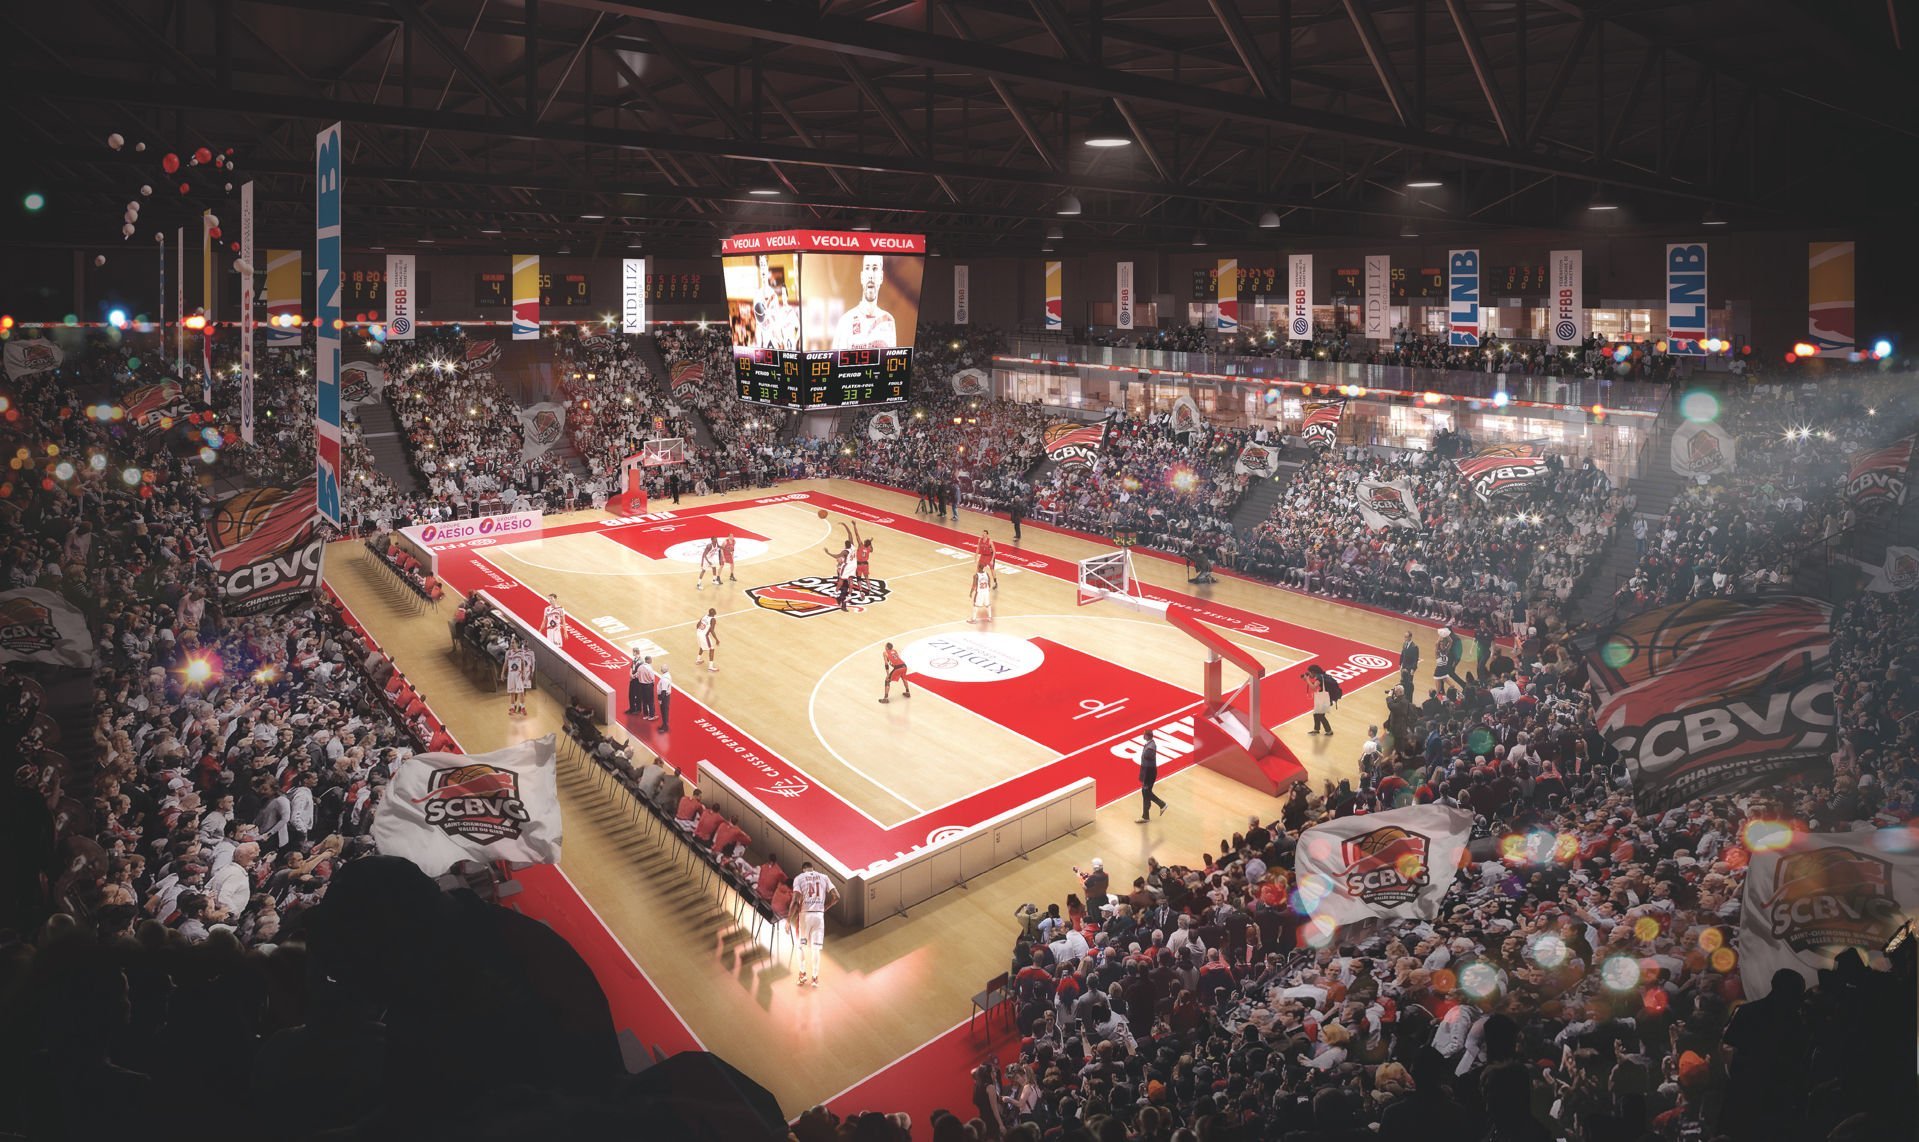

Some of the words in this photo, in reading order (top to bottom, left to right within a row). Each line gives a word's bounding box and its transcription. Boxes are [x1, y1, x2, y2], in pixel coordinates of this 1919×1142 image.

[733, 239, 761, 249] VEOLIA
[766, 235, 797, 247] VEOLIA
[811, 235, 860, 248] VEOLIA
[870, 238, 915, 249] VEOLIA
[318, 130, 340, 427] LNB
[354, 272, 363, 282] 18
[366, 271, 380, 282] 20
[1391, 268, 1406, 280] 55
[1434, 275, 1442, 287] 0
[492, 282, 500, 294] 4
[578, 282, 586, 295] 0
[1347, 276, 1355, 287] 4
[1451, 251, 1478, 322] LNB
[1669, 245, 1706, 328] LNB
[394, 289, 407, 316] FFBB
[626, 263, 637, 328] KIDILIZ
[1296, 289, 1305, 316] FFBB
[1369, 259, 1380, 333] KIDILIZ
[1560, 289, 1573, 319] FFBB
[740, 358, 750, 370] 89
[784, 362, 799, 377] 104
[812, 362, 830, 376] 89
[886, 358, 907, 371] 104
[866, 369, 872, 379] 4
[760, 387, 769, 398] 33
[813, 392, 823, 403] 12
[843, 390, 858, 400] 33
[865, 388, 872, 398] 2
[893, 386, 900, 396] 9
[494, 518, 532, 532] AESIO
[437, 526, 475, 540] AESIO
[1203, 610, 1242, 625] CAISSE
[928, 639, 1012, 675] KIDILIZ
[1326, 662, 1368, 684] FFB
[742, 752, 780, 777] CAISSE
[444, 821, 493, 829] SAINT-CHAMOND
